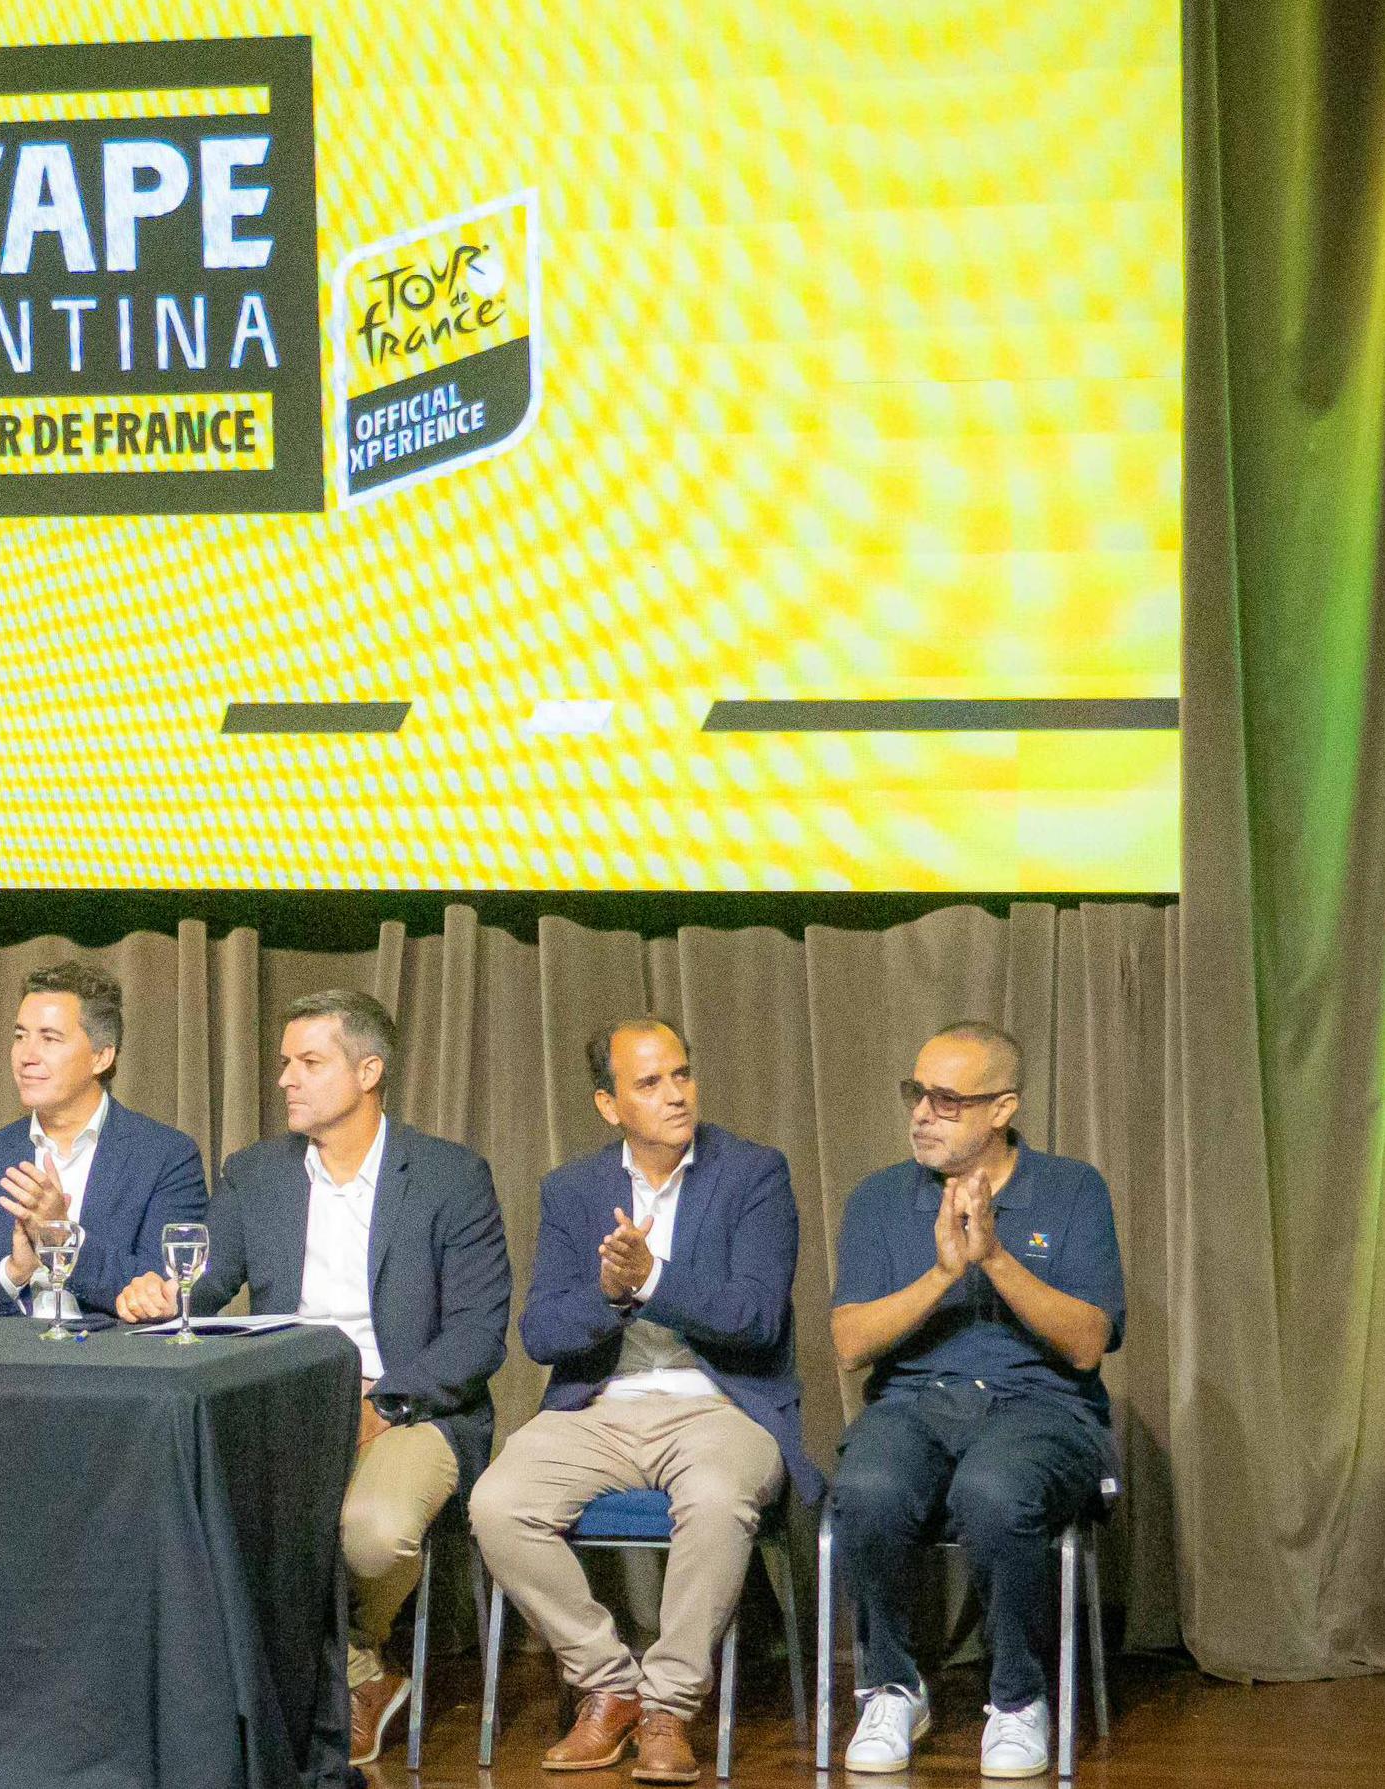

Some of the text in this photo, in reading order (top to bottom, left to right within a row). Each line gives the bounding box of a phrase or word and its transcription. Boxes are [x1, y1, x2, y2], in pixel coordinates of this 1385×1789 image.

[450, 291, 469, 308] de
[33, 412, 82, 457] DE
[95, 410, 256, 455] FRANCE
[355, 383, 463, 442] OFFICIAL
